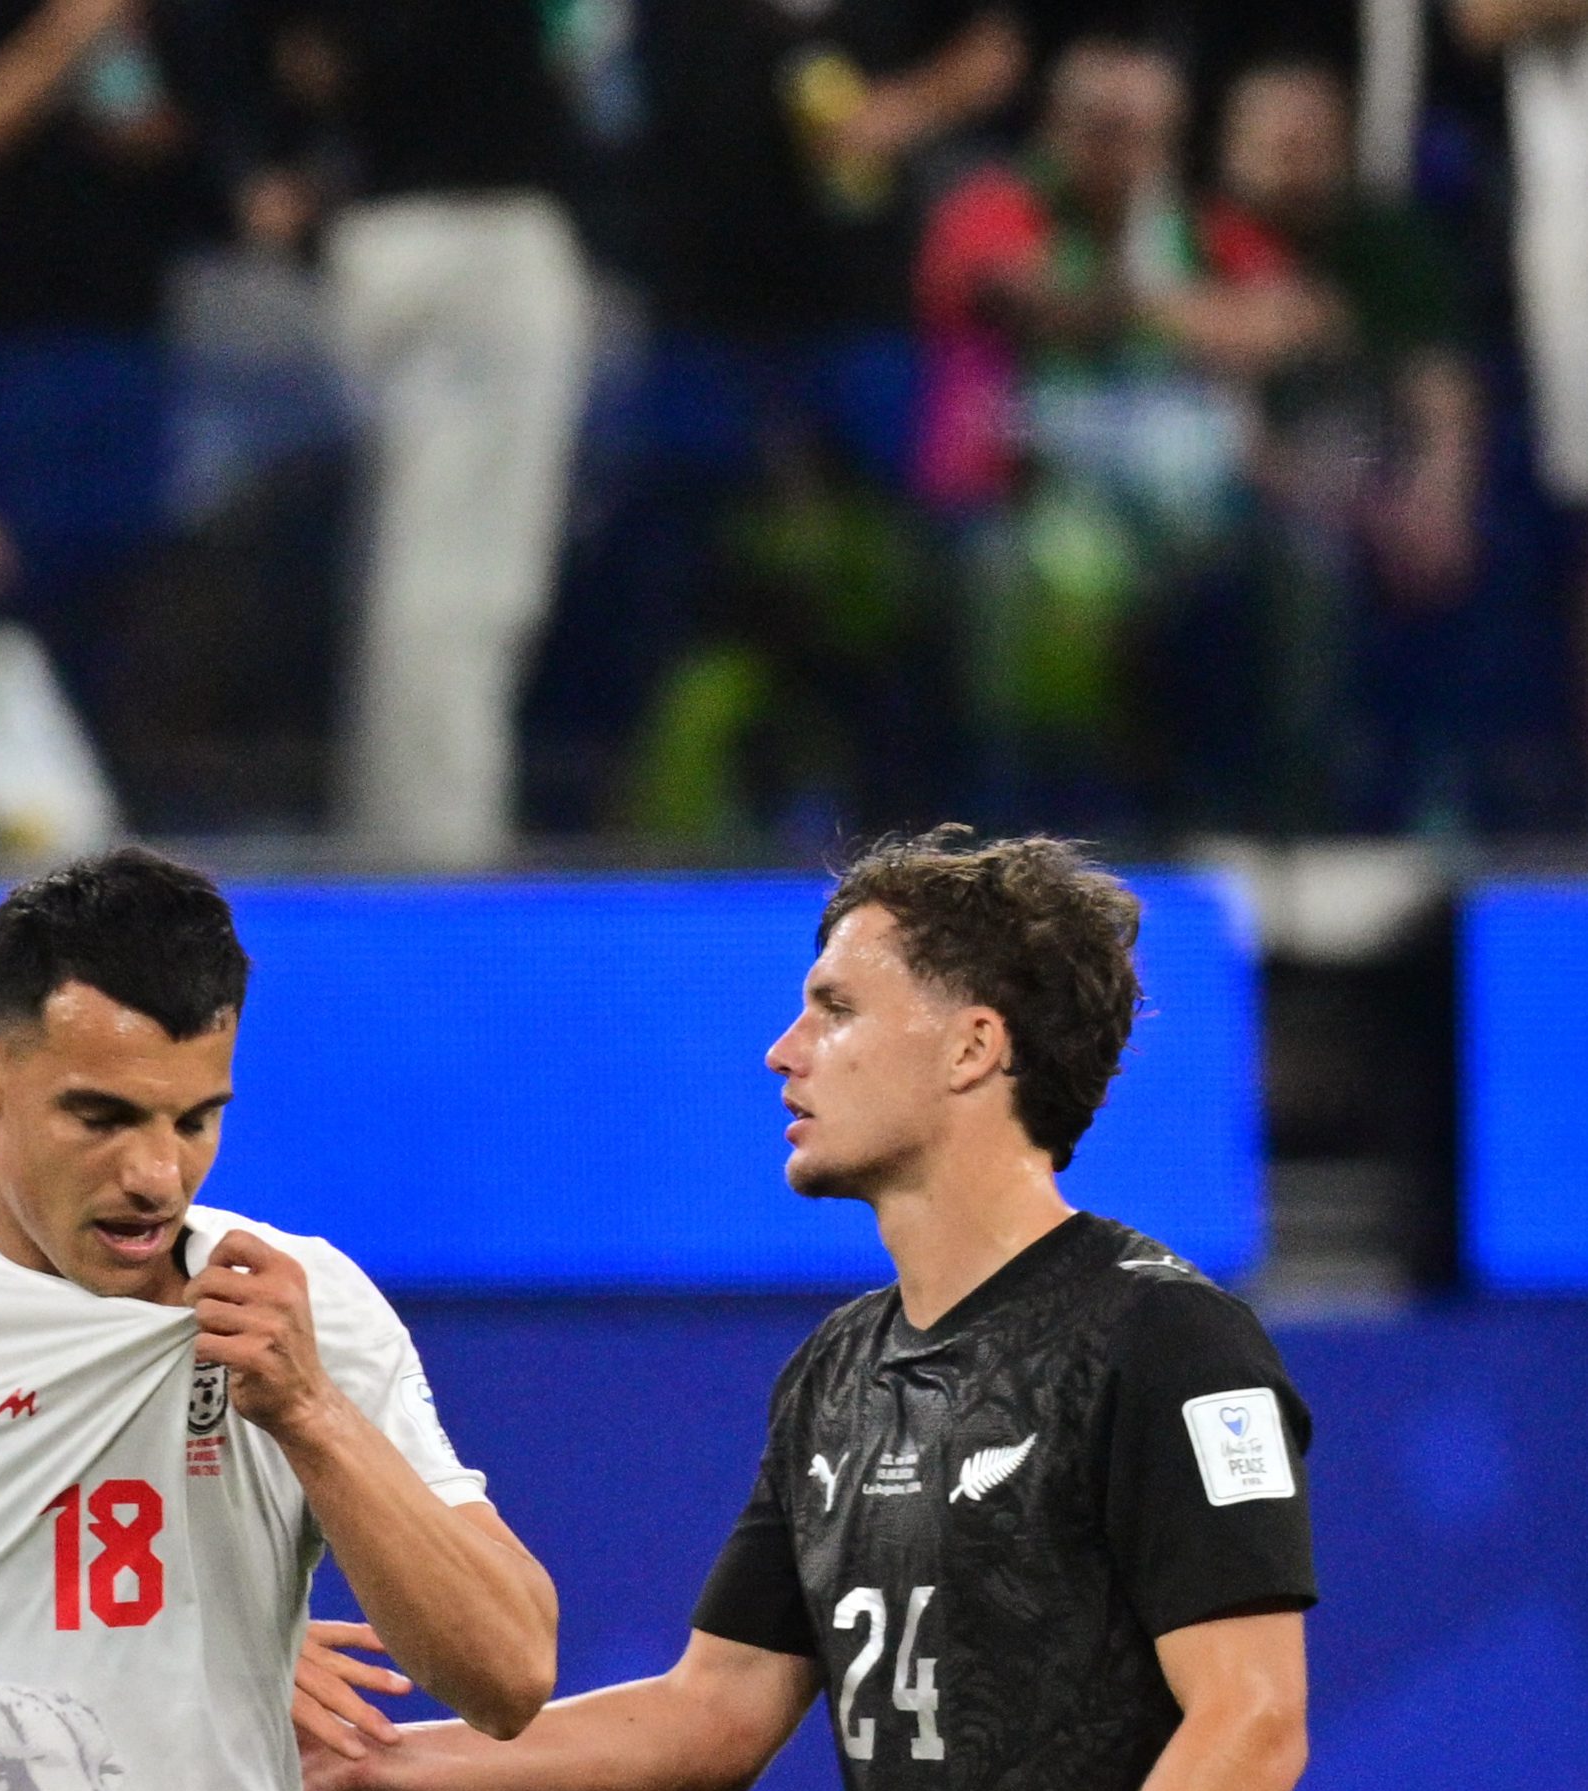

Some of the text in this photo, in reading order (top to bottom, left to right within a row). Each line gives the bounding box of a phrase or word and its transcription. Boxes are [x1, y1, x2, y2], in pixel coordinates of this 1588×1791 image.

[1229, 1458, 1267, 1477] PEACE
[40, 1479, 164, 1631] 18
[833, 1585, 945, 1761] 24
